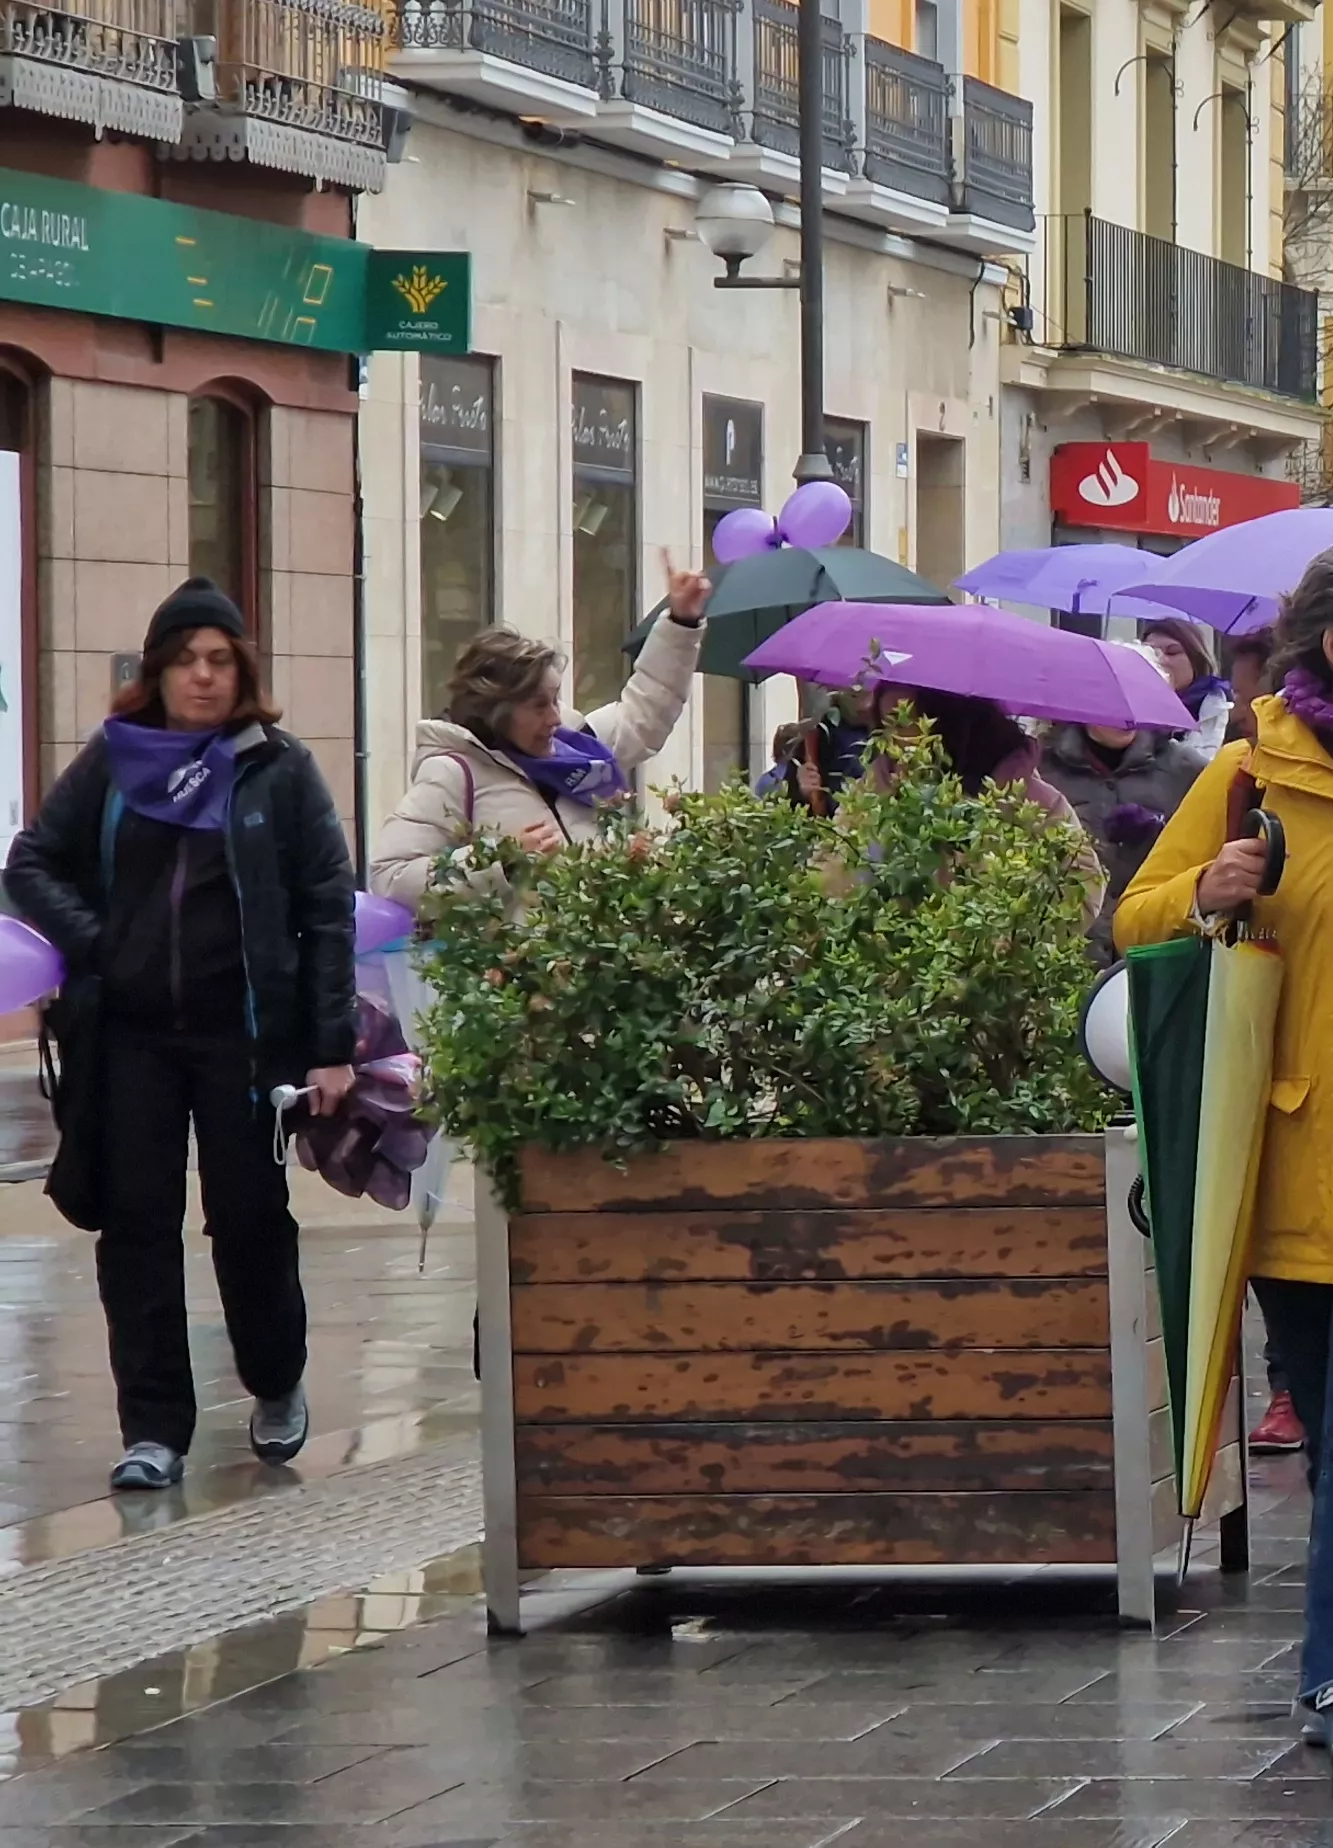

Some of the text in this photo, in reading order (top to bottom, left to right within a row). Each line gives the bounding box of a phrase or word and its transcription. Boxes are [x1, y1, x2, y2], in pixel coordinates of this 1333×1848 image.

[1, 202, 90, 251] CAJA RURAL
[398, 320, 439, 329] CAJERO
[1179, 483, 1221, 526] Santander
